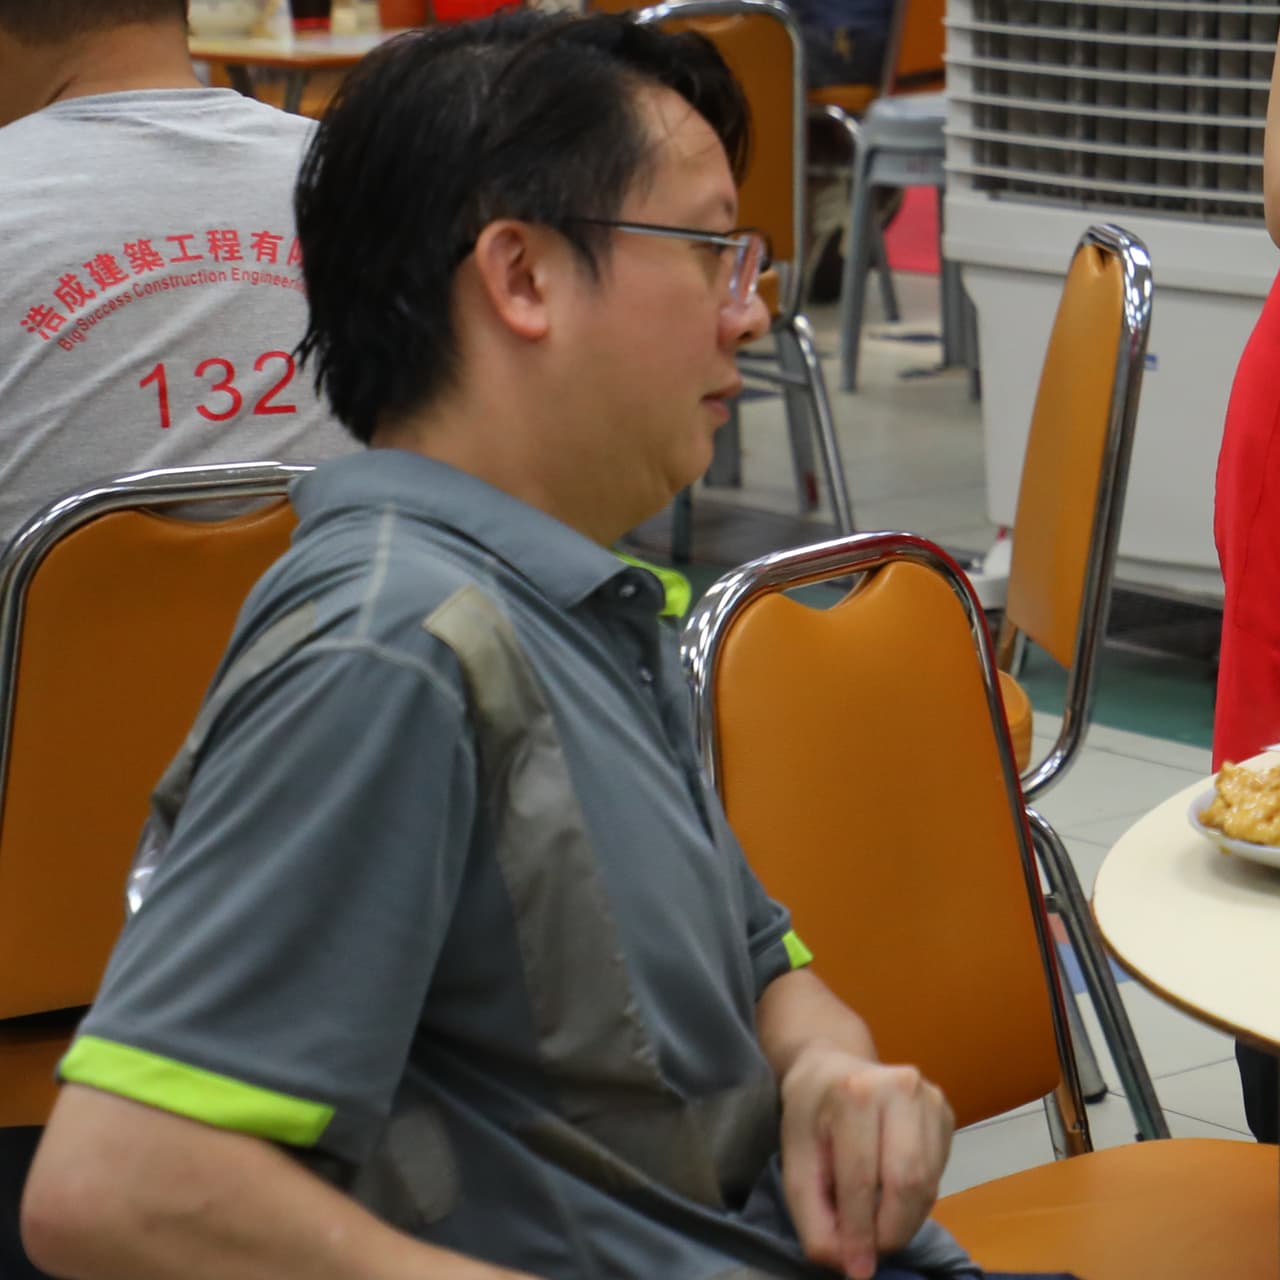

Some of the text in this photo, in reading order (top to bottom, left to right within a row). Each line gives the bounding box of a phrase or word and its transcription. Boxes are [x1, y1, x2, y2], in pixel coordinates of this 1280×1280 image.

[57, 328, 87, 352] Big
[76, 292, 133, 331] Success
[132, 269, 228, 299] Construction
[138, 351, 297, 428] 132
